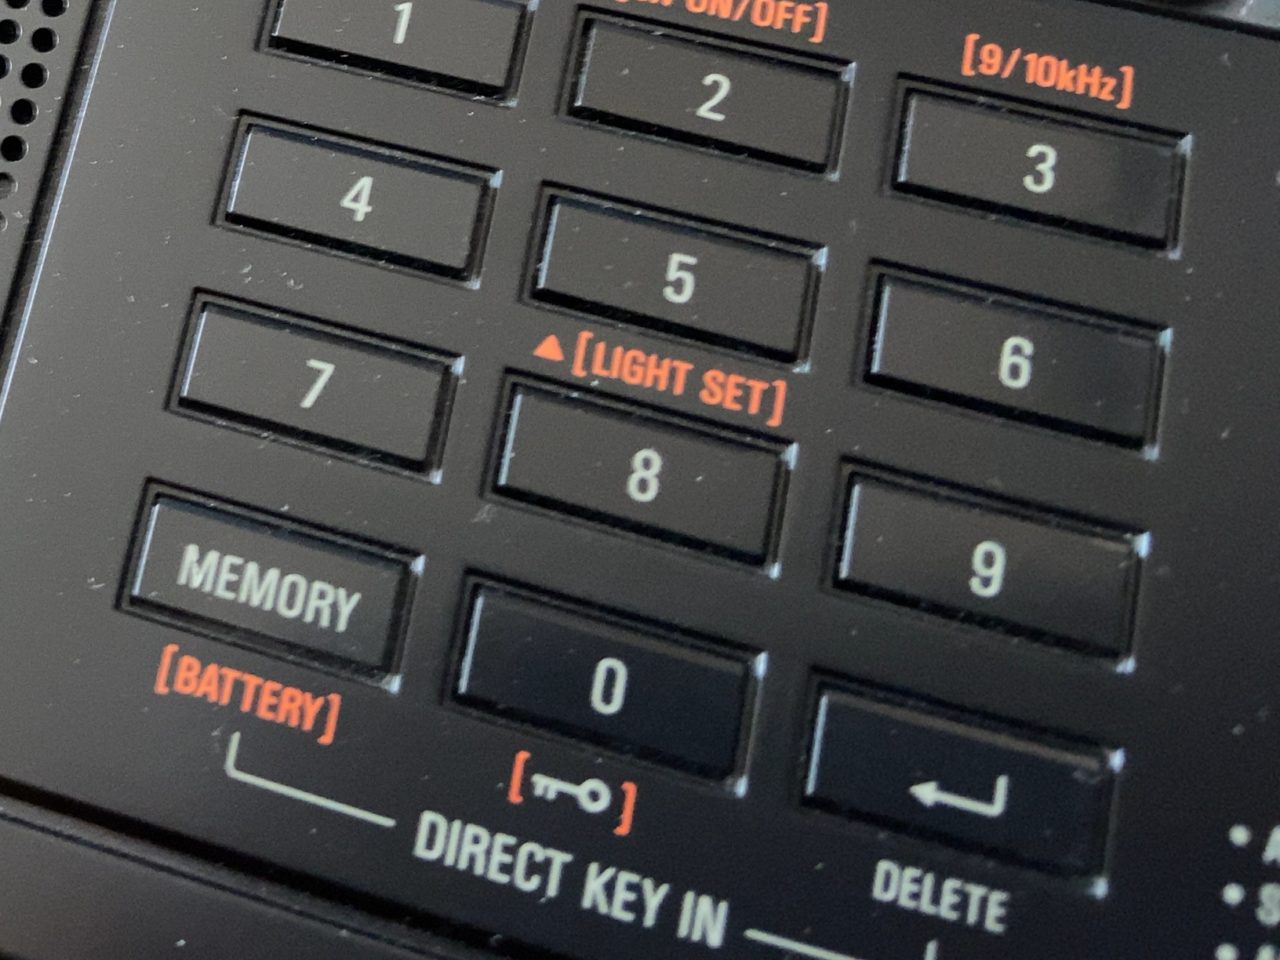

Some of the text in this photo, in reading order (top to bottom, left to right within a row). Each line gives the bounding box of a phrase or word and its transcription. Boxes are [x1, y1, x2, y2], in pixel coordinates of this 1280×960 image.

[393, 0, 413, 45] 1
[695, 71, 732, 123] 2
[961, 32, 1135, 109] [9/10kHz]
[1022, 144, 1057, 194] 3
[340, 175, 374, 223] 4
[661, 252, 698, 306] 5
[300, 360, 335, 410] 7
[571, 330, 787, 426] [LIGHT SET]
[998, 335, 1034, 390] 6
[627, 448, 663, 503] 8
[177, 543, 361, 634] MEMORY
[969, 540, 1007, 600] 9
[154, 644, 341, 744] [BATTERY]
[589, 657, 628, 716] 0
[414, 810, 730, 948] DIRECT KEY IN
[872, 858, 1011, 933] DELETE
